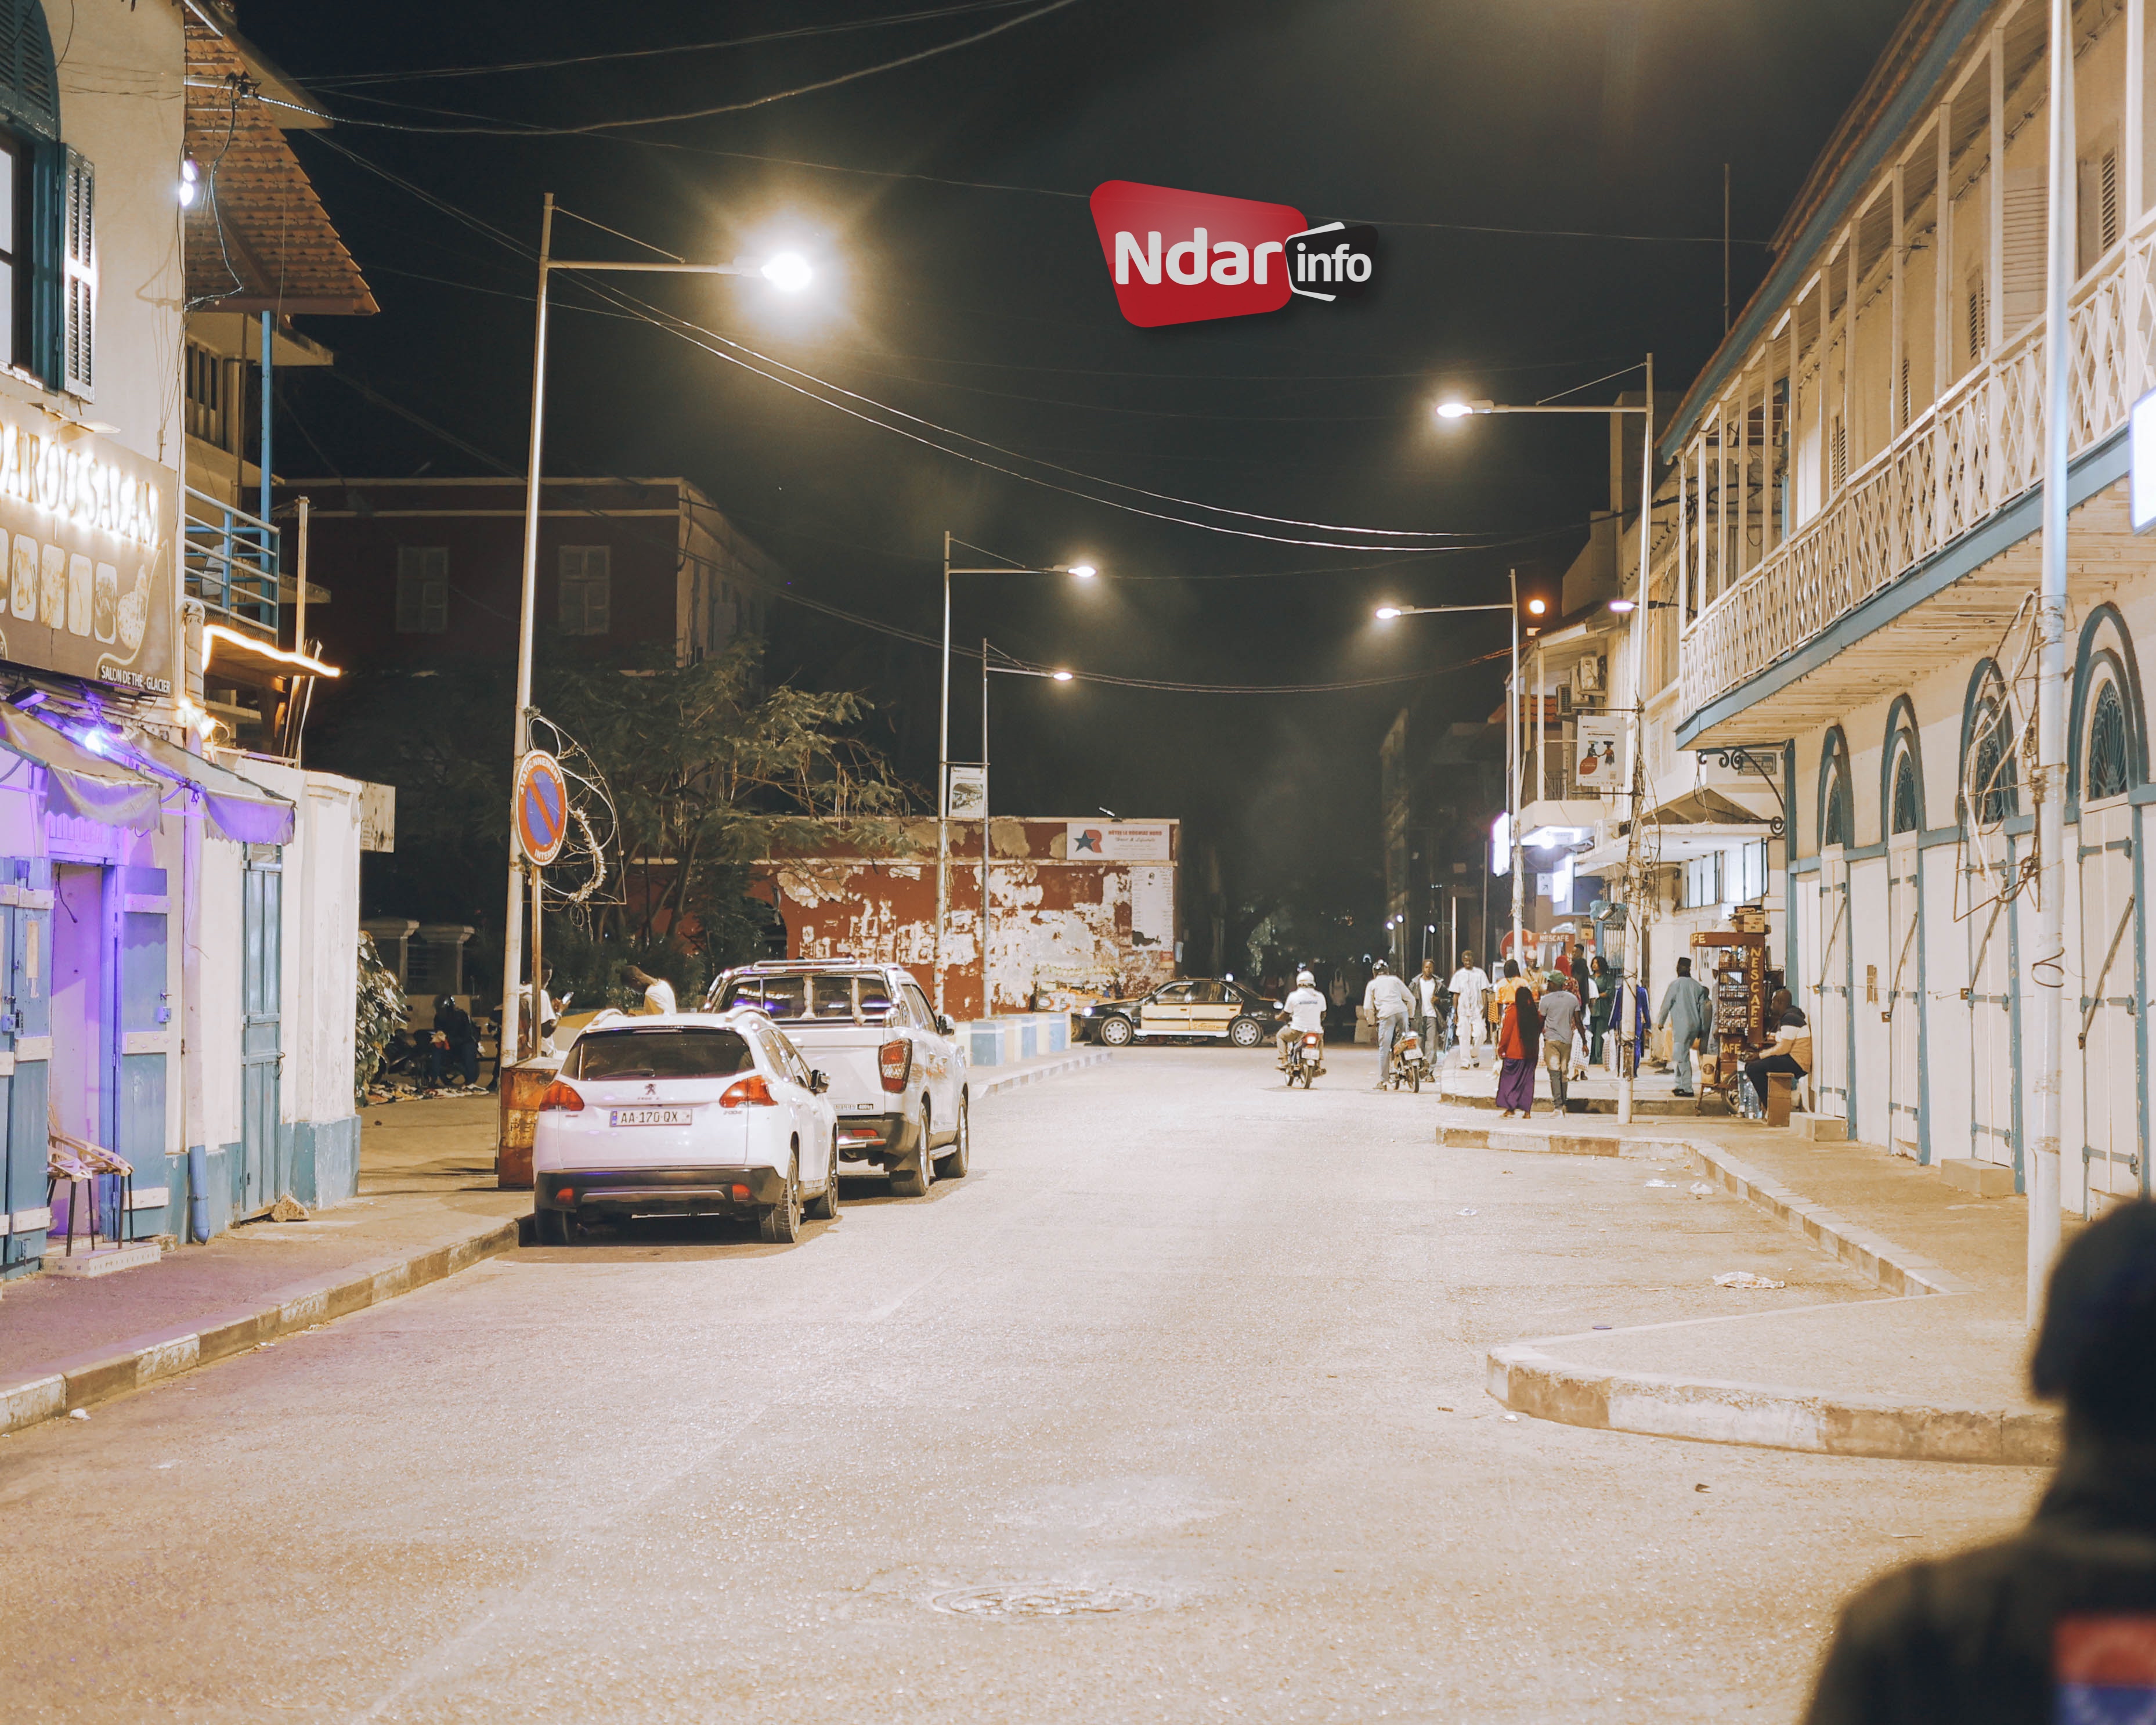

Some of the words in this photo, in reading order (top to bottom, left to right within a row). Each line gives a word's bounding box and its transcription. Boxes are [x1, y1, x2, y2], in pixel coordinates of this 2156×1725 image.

[101, 665, 122, 683] SALON
[122, 670, 131, 685] DE
[132, 672, 143, 688] THÉ
[146, 676, 171, 694] GLACIER
[1539, 934, 1570, 943] NESCAFE
[1750, 947, 1763, 1028] NESCAFE
